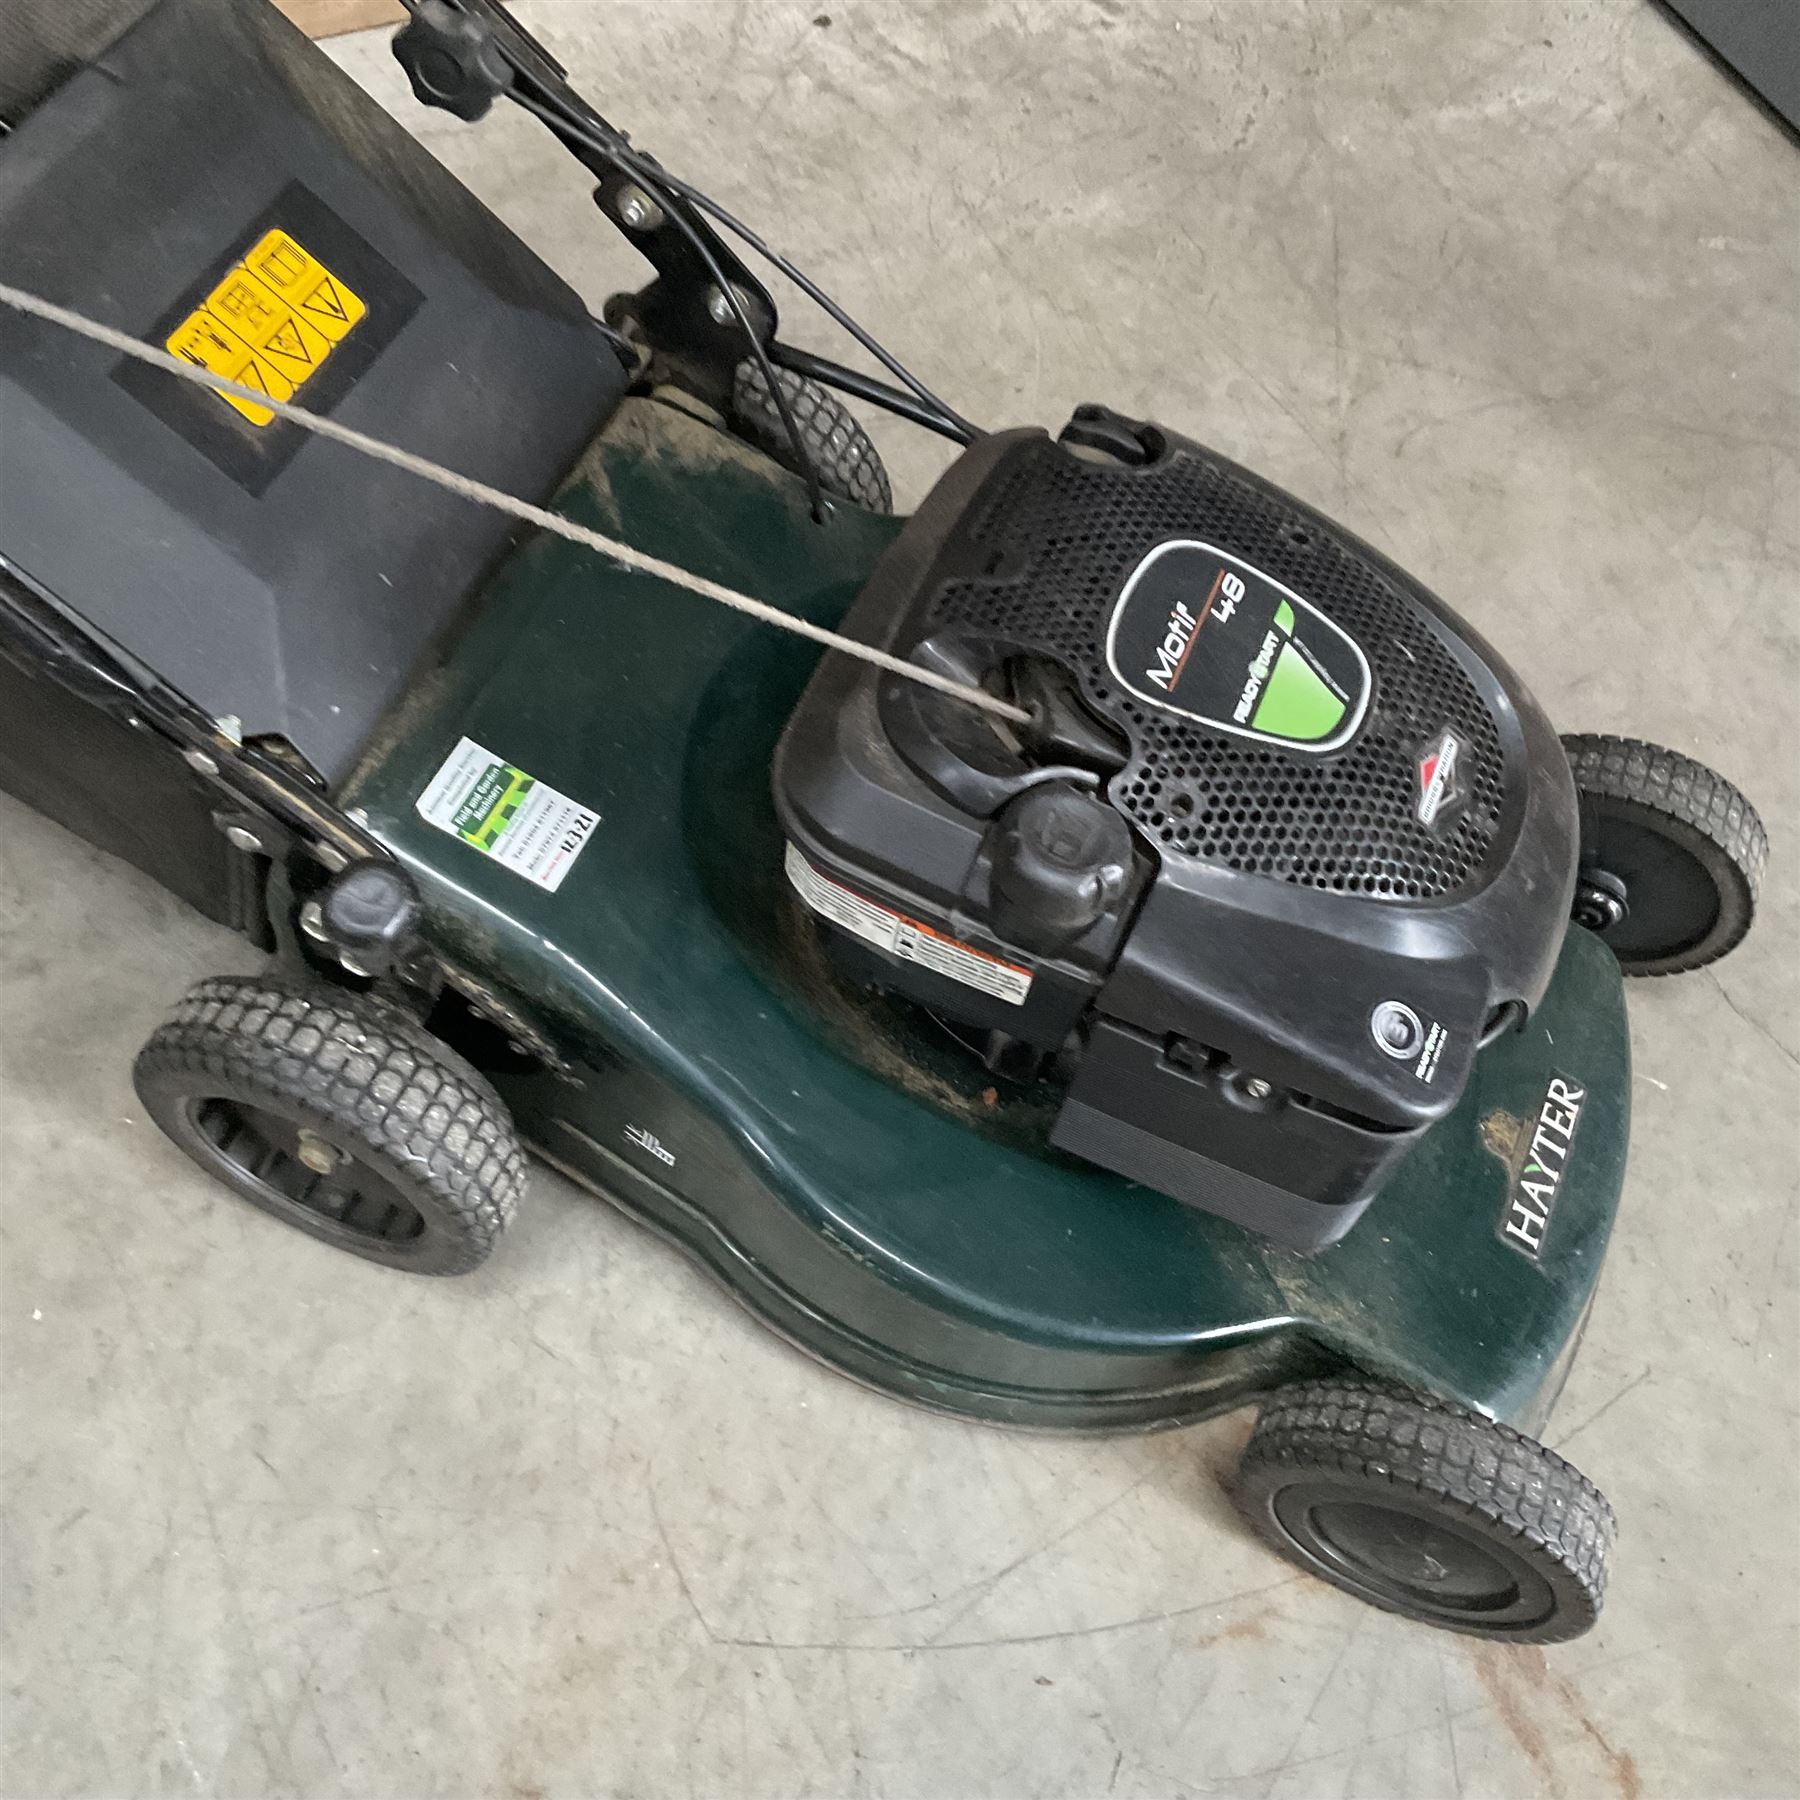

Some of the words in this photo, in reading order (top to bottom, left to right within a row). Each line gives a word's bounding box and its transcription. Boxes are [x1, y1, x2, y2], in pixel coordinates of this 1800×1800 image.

[1210, 572, 1246, 623] 48
[1146, 601, 1197, 690] Motif
[454, 805, 474, 826] Field
[469, 791, 483, 809] and
[477, 767, 501, 795] Garden
[472, 783, 504, 822] Machinery
[1506, 1078, 1585, 1251] HAYTER
